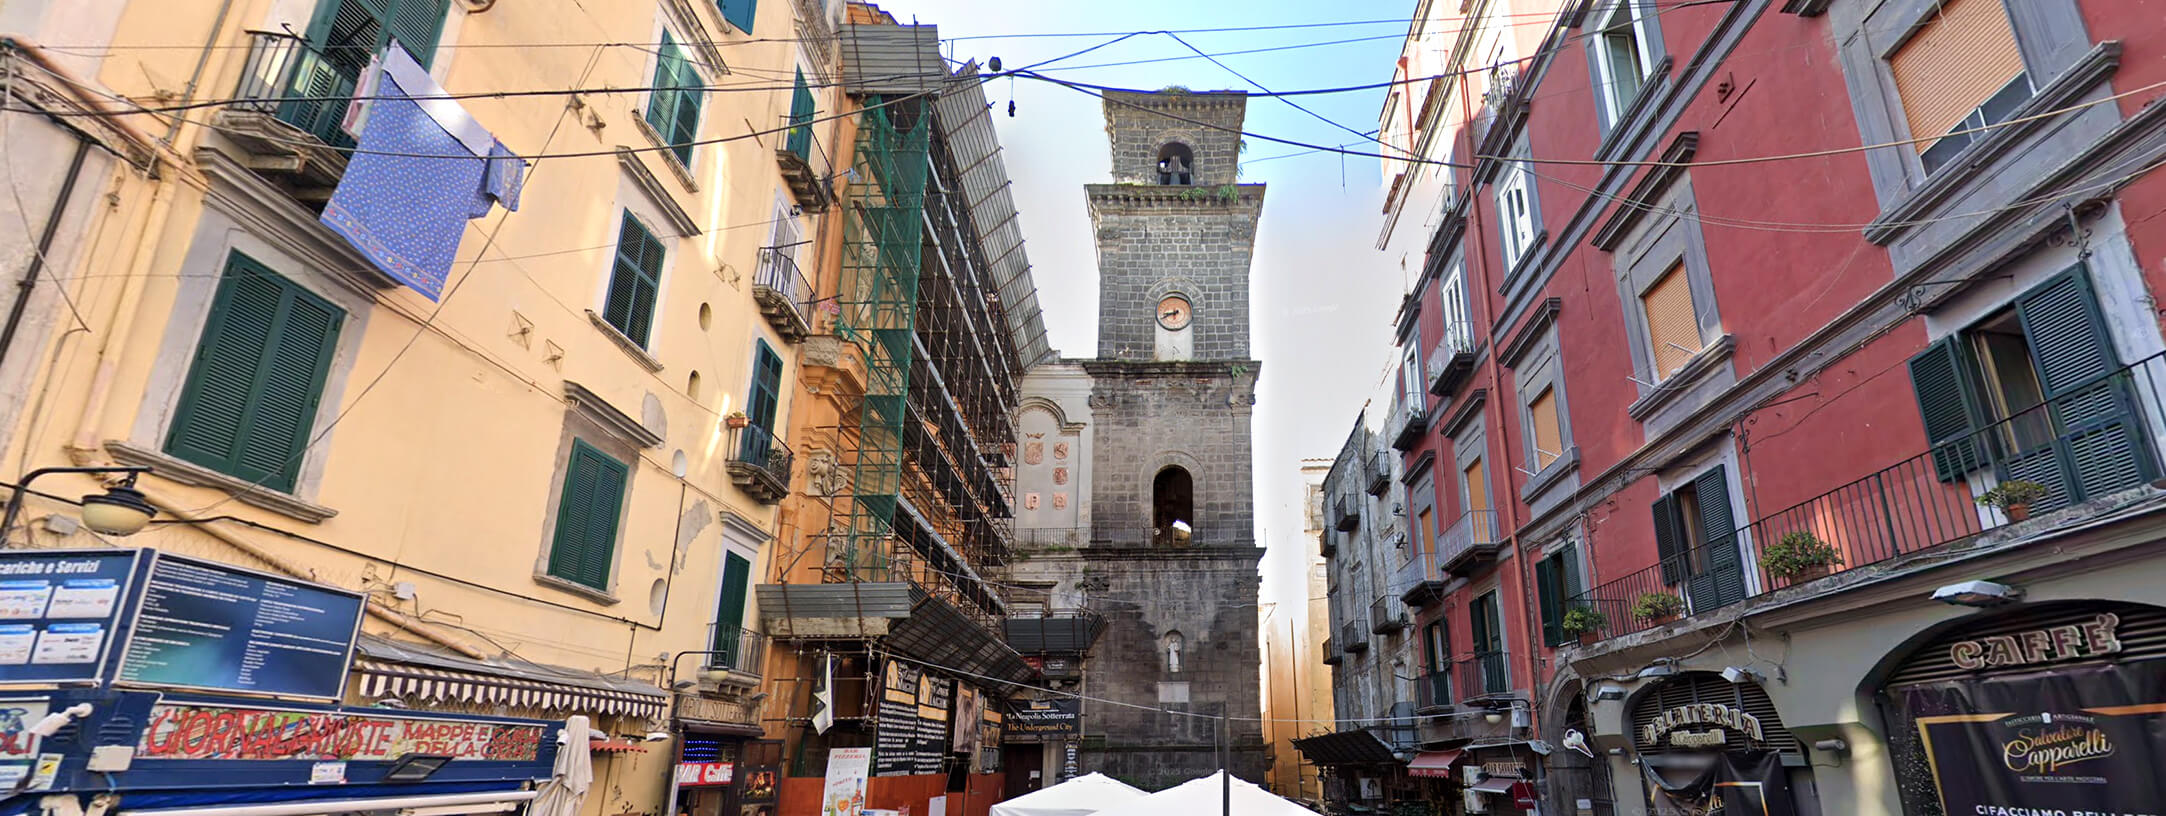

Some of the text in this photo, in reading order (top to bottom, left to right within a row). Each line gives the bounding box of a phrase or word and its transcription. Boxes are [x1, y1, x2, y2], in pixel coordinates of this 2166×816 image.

[45, 563, 54, 574] e
[56, 560, 100, 573] Servizi
[1016, 712, 1041, 720] Neapolis
[1042, 712, 1075, 720] Sotterrata
[1643, 703, 1764, 745] GELATERIA
[402, 720, 474, 741] MAPPE
[479, 726, 489, 742] E
[1008, 723, 1073, 732] The Underground City
[2017, 725, 2084, 751] Salvatore
[414, 740, 479, 757] DELLA
[2002, 729, 2115, 773] Capparelli
[677, 764, 702, 783] BAR
